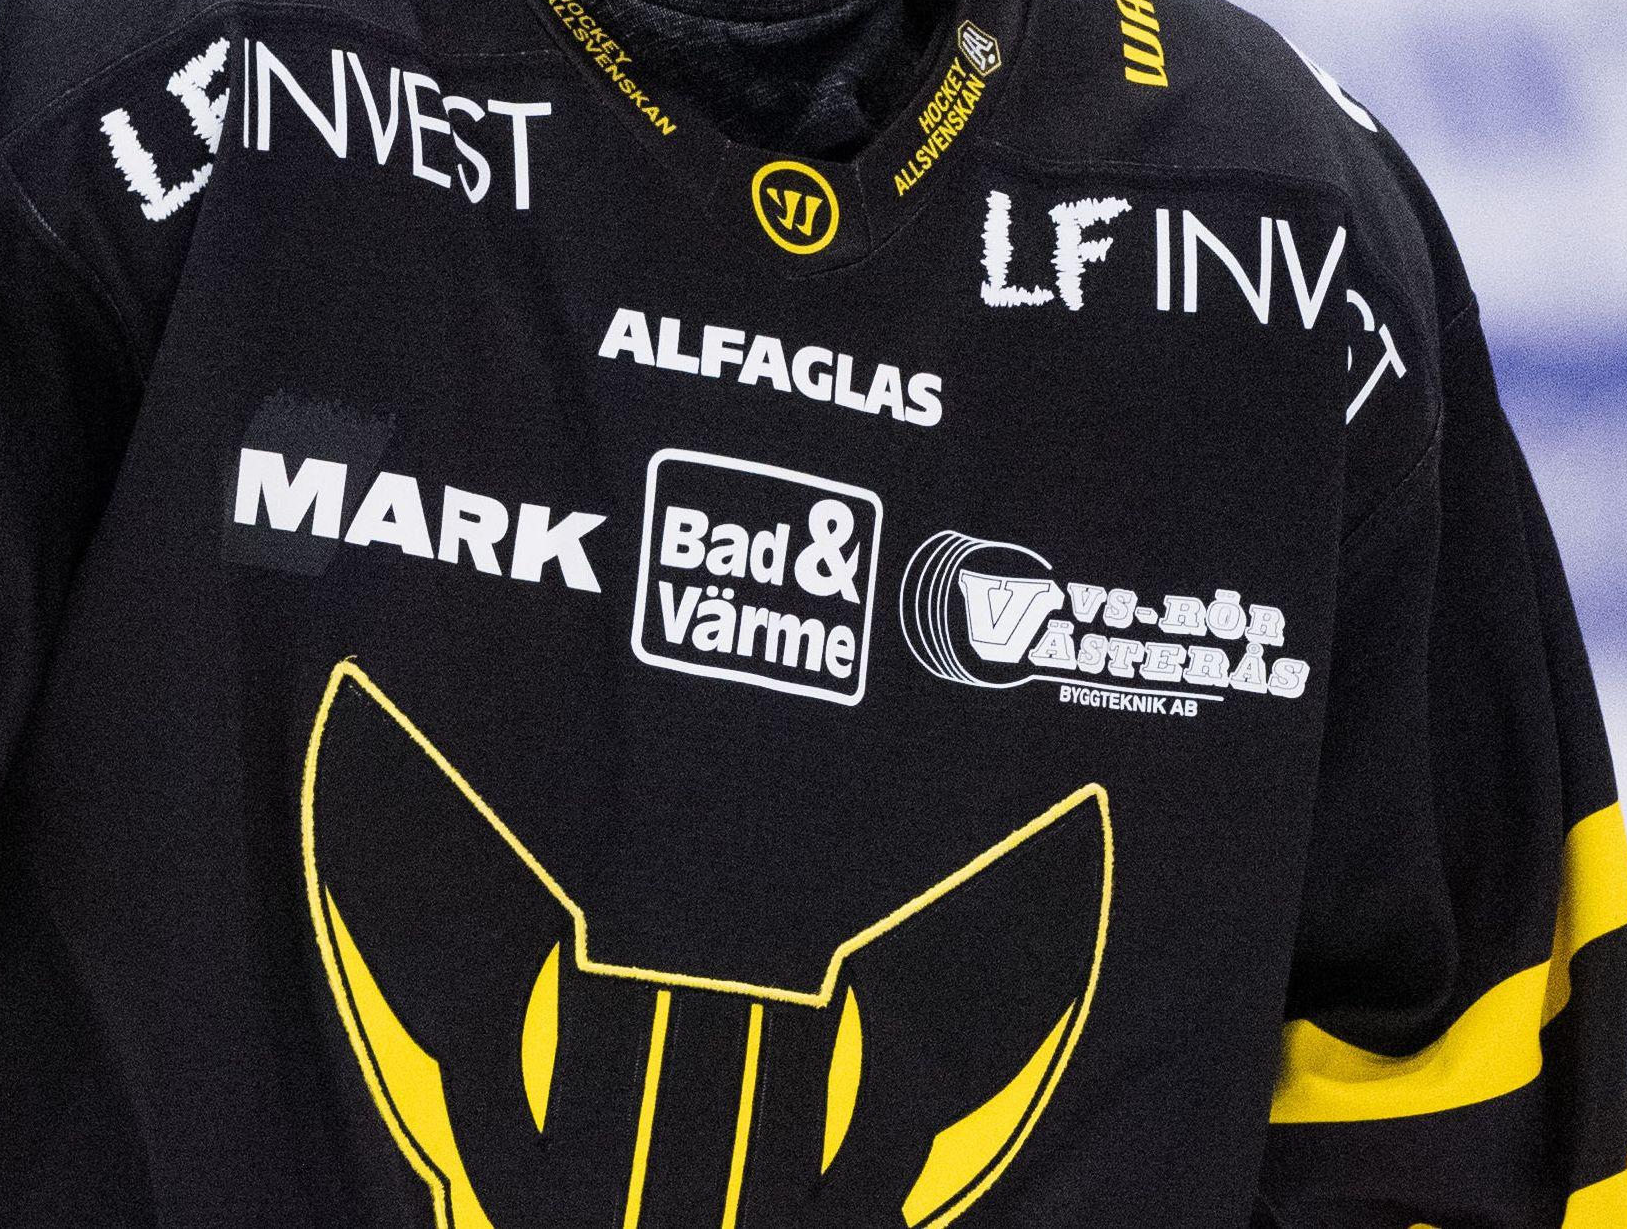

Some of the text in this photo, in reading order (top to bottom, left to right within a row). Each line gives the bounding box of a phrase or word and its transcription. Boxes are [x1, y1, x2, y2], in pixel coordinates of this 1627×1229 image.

[242, 37, 553, 211] INVEST
[892, 72, 987, 197] ALLSVENSKAN
[917, 56, 968, 135] HOCKEY
[980, 189, 1133, 312] LF
[597, 307, 944, 428] ALFAGLAS
[233, 446, 609, 594] MARK
[658, 580, 856, 679] Värme
[1059, 684, 1199, 718] BYGGTEKNIK AB
